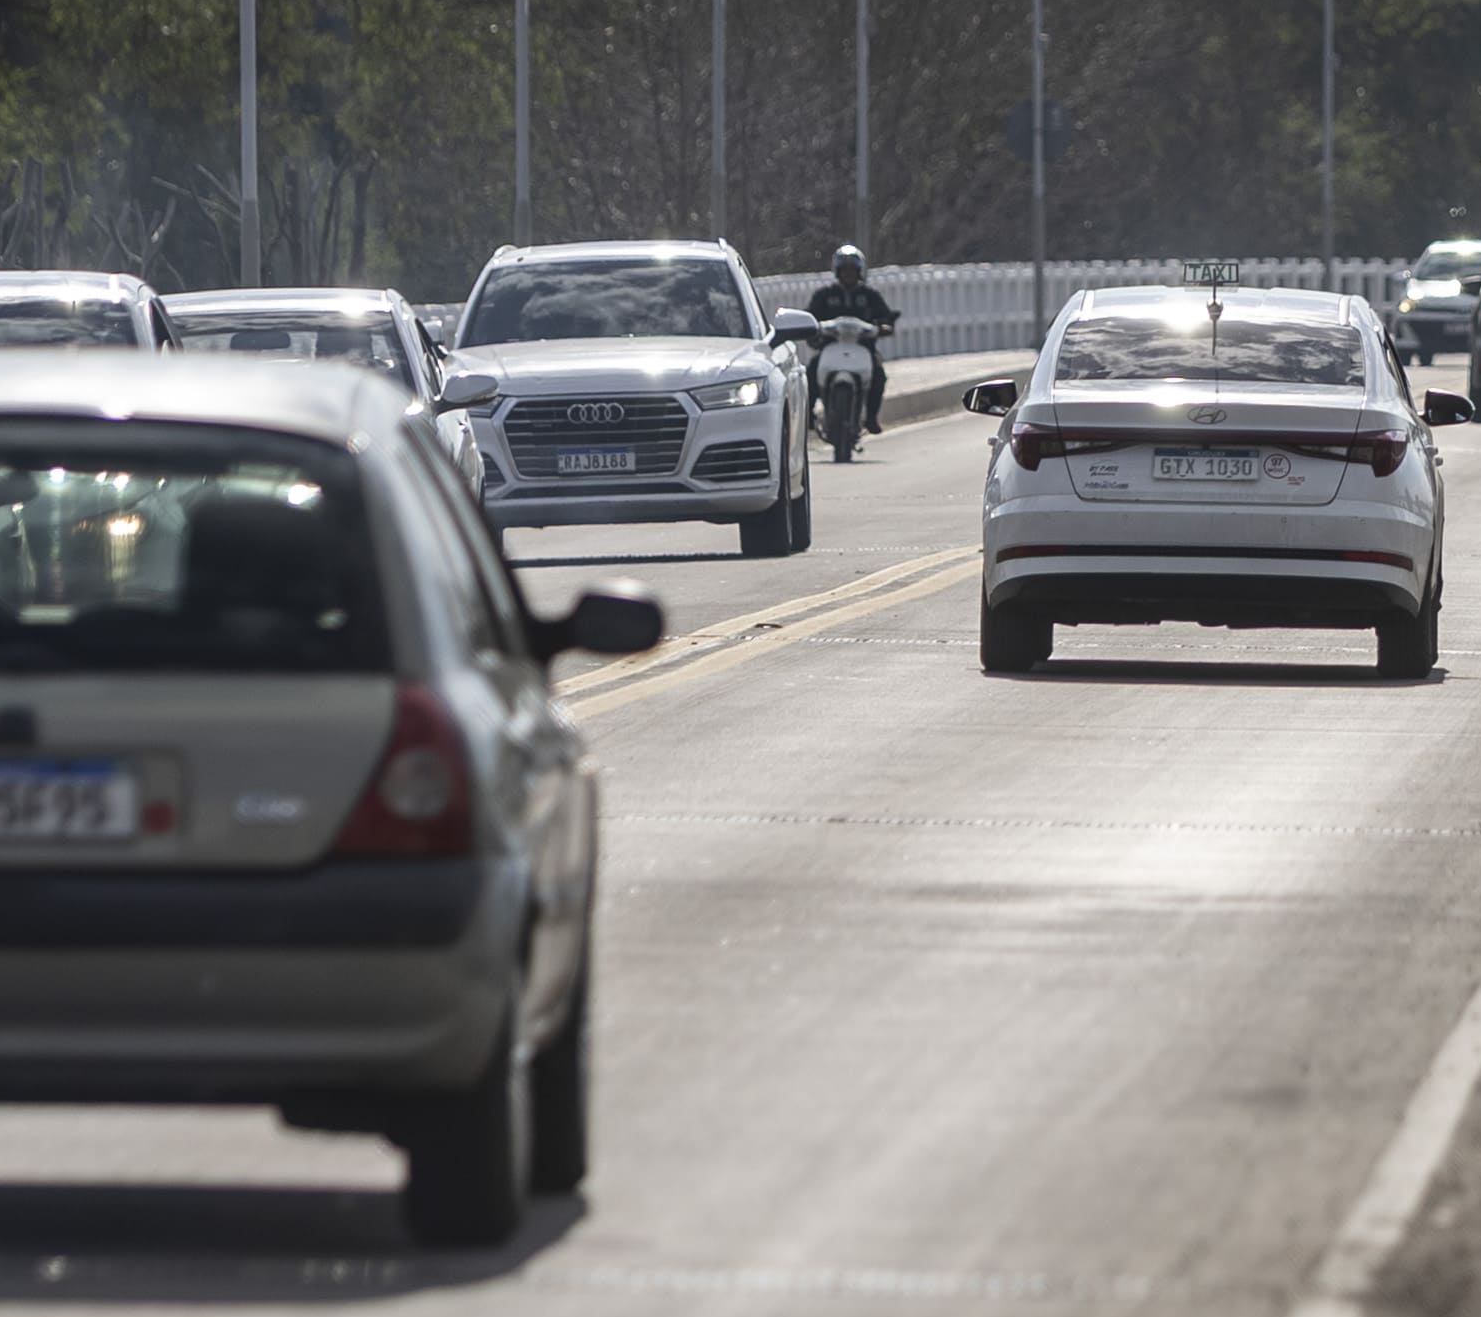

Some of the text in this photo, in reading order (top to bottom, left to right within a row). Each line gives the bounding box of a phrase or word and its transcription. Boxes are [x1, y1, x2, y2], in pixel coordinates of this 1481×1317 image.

[1188, 264, 1232, 281] TAXI
[1160, 458, 1254, 476] GTX 1030
